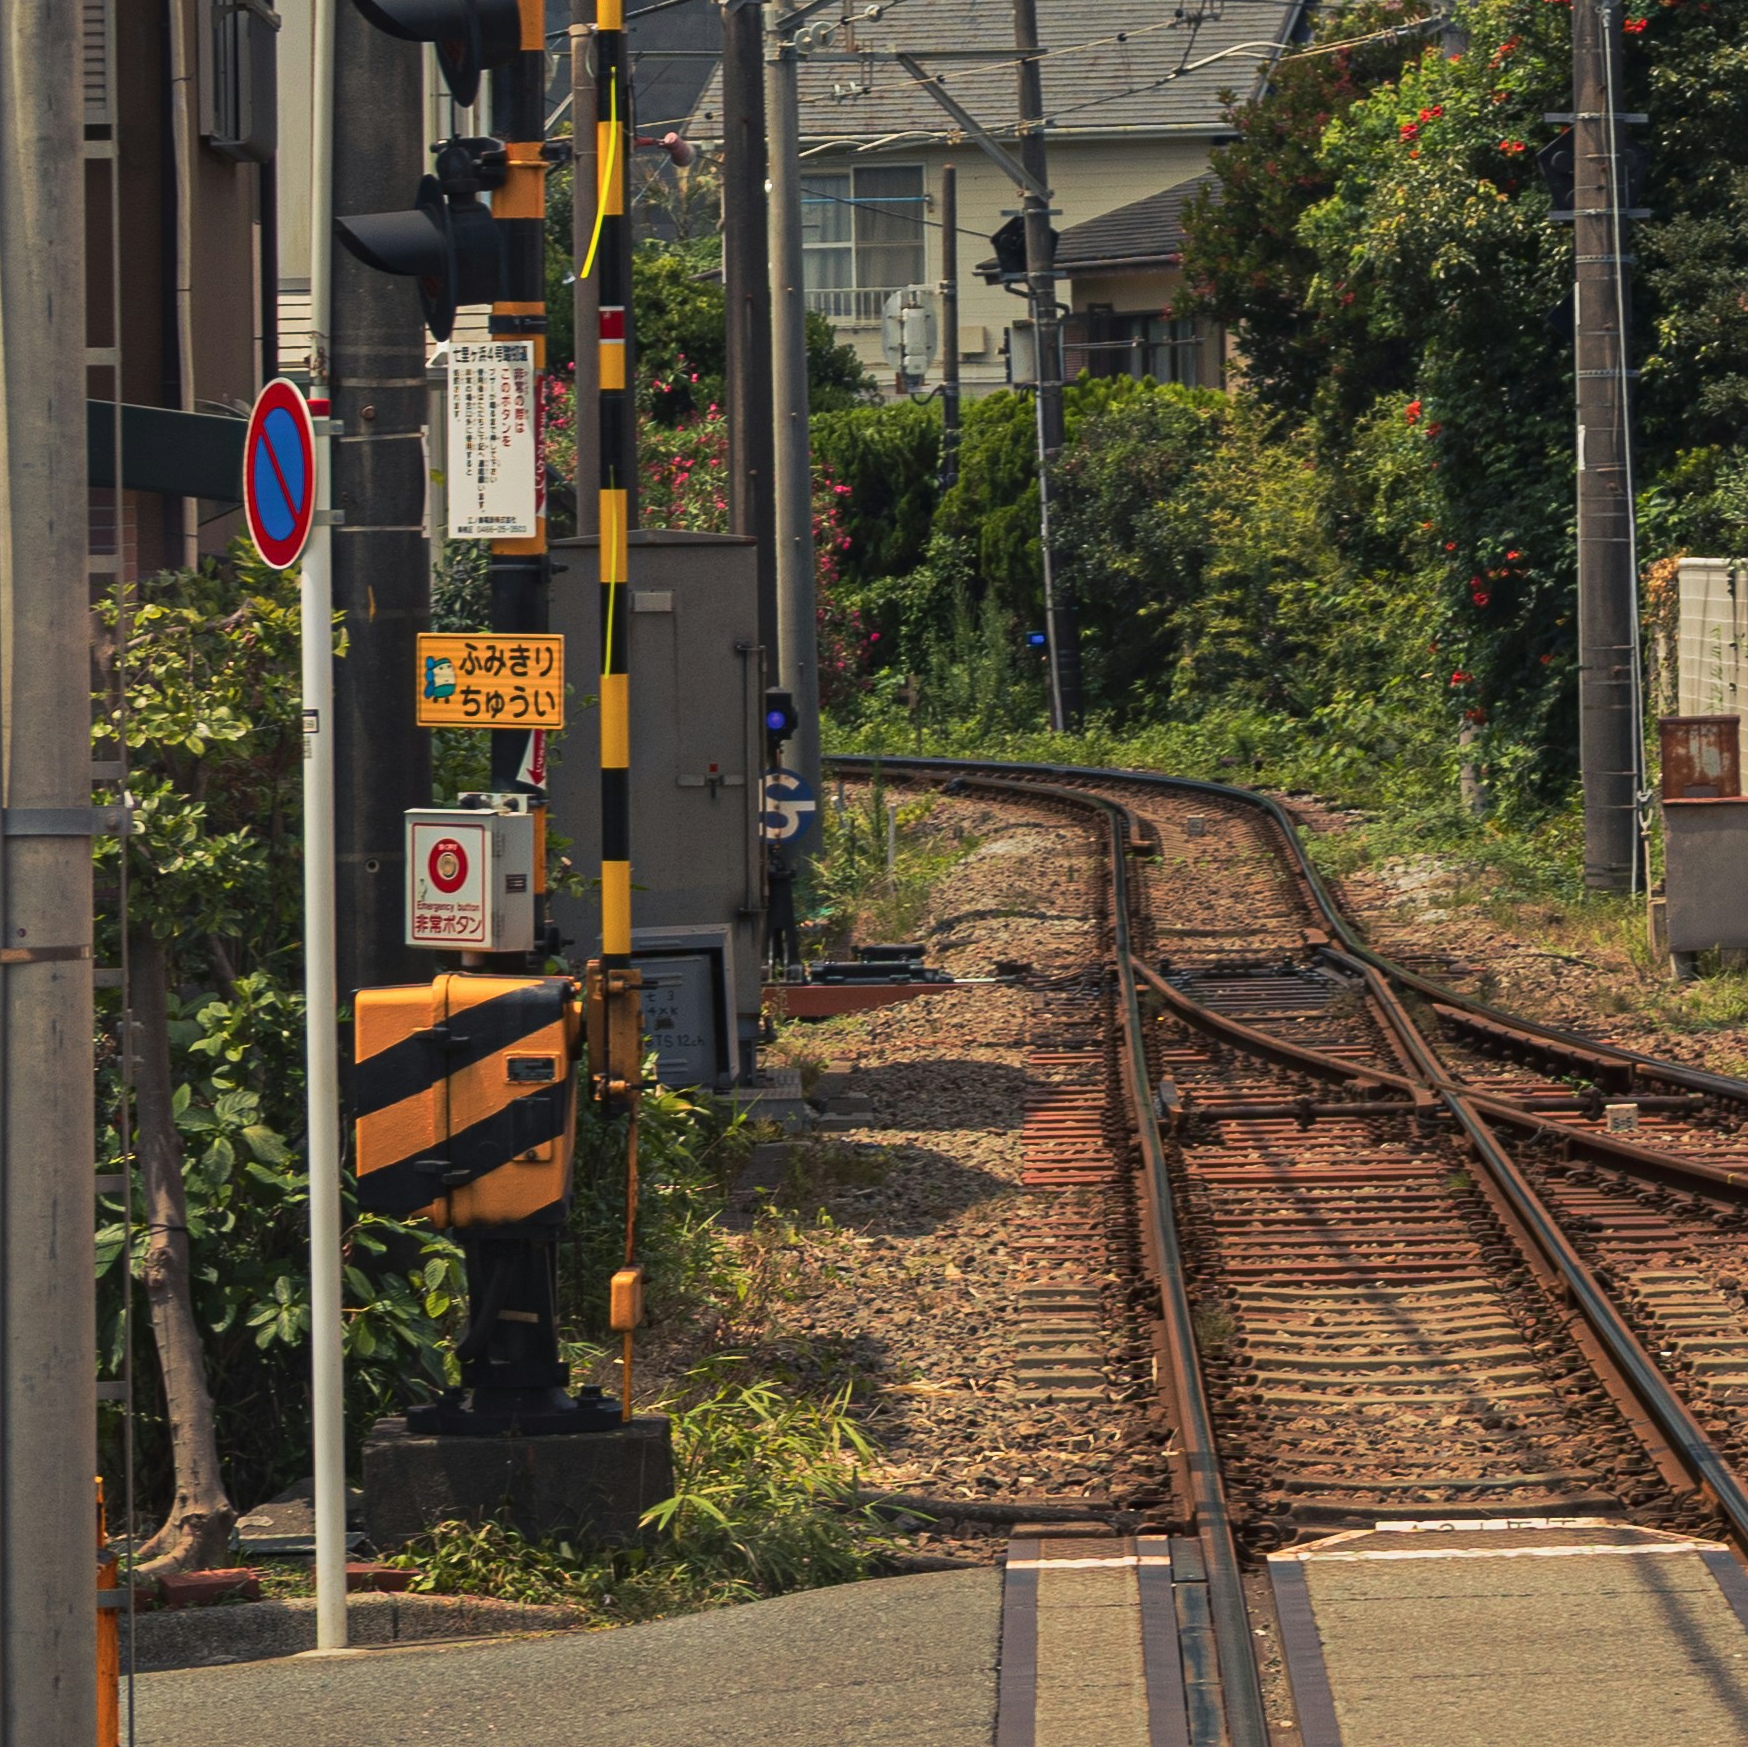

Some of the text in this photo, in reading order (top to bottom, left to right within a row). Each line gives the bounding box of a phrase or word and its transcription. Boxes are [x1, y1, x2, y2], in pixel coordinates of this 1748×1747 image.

[500, 368, 511, 447] このボタンを
[459, 642, 553, 677] ふみきり
[460, 685, 556, 719] ちゅうい
[417, 900, 481, 912] Emergency button
[415, 913, 482, 935] 非常ボタン
